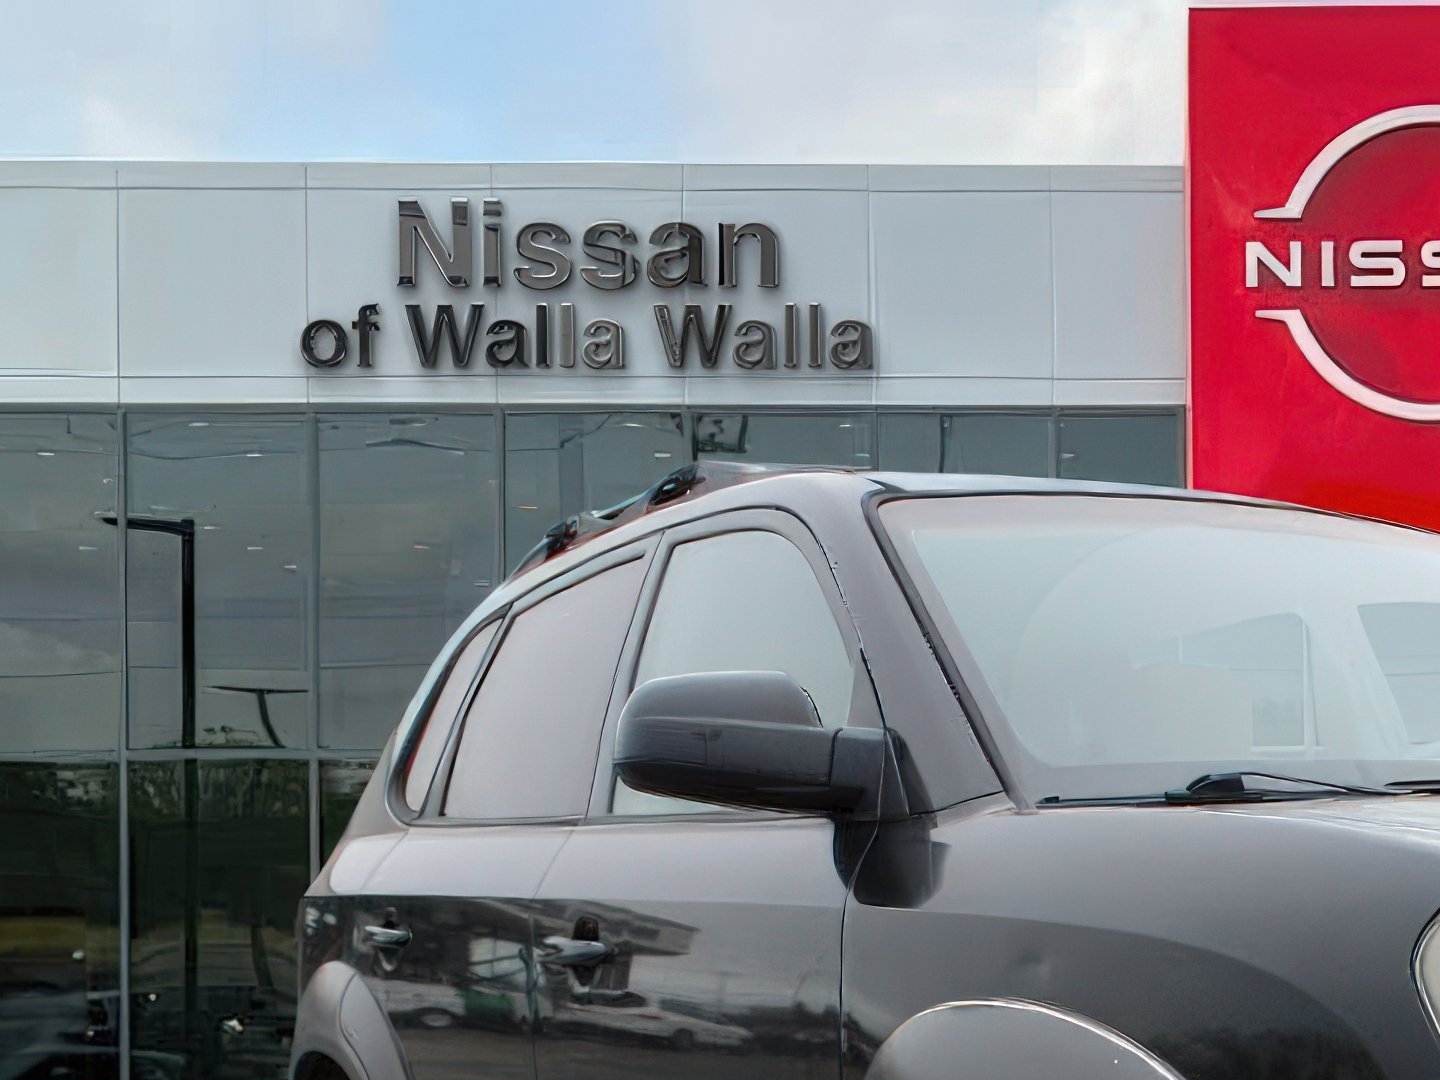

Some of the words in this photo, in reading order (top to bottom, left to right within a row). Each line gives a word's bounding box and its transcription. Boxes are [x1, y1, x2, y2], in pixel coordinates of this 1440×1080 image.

[397, 196, 780, 290] Nissan
[300, 303, 380, 369] of
[404, 303, 626, 370] Walla
[653, 302, 875, 370] Walla
